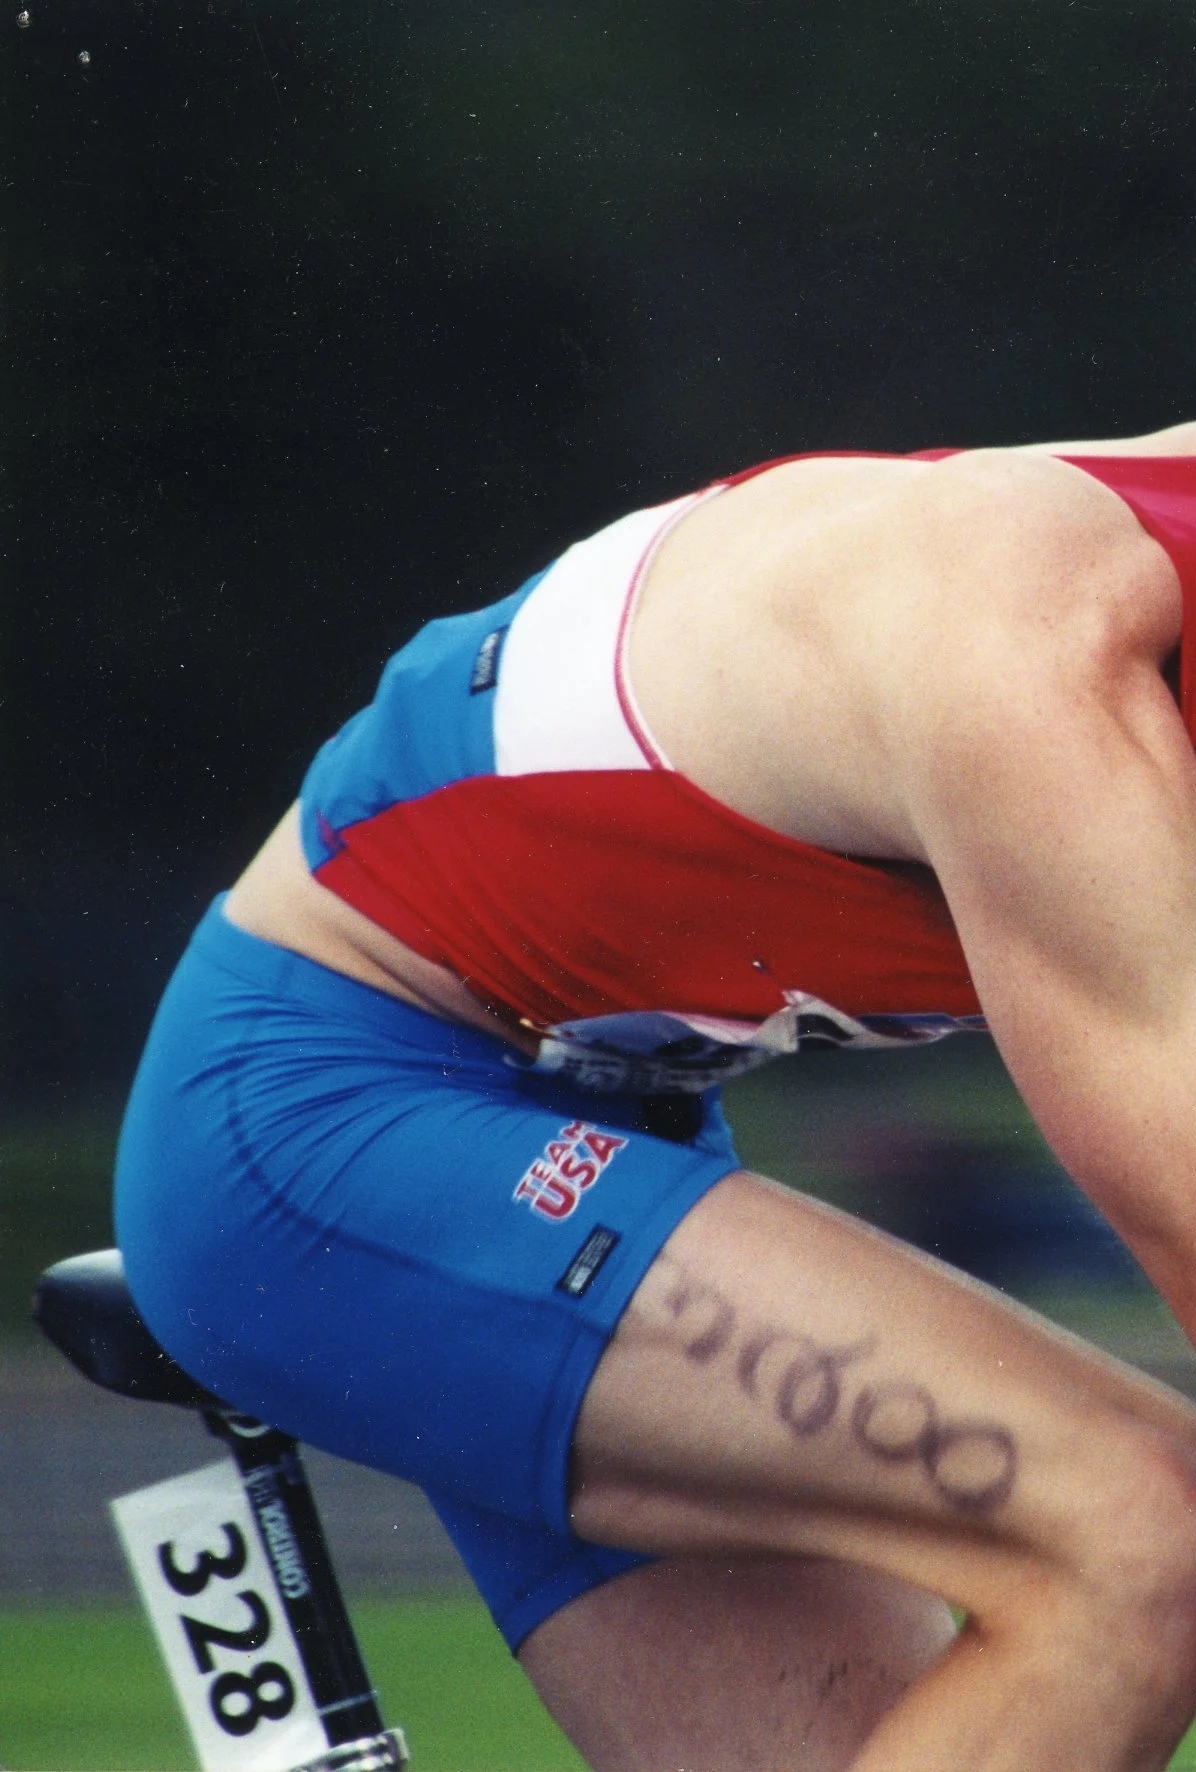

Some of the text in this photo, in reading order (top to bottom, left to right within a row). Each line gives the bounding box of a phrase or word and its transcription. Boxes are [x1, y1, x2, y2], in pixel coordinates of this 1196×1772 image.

[513, 1119, 594, 1202] TEAM
[531, 1130, 629, 1222] USA
[158, 1522, 295, 1737] 328
